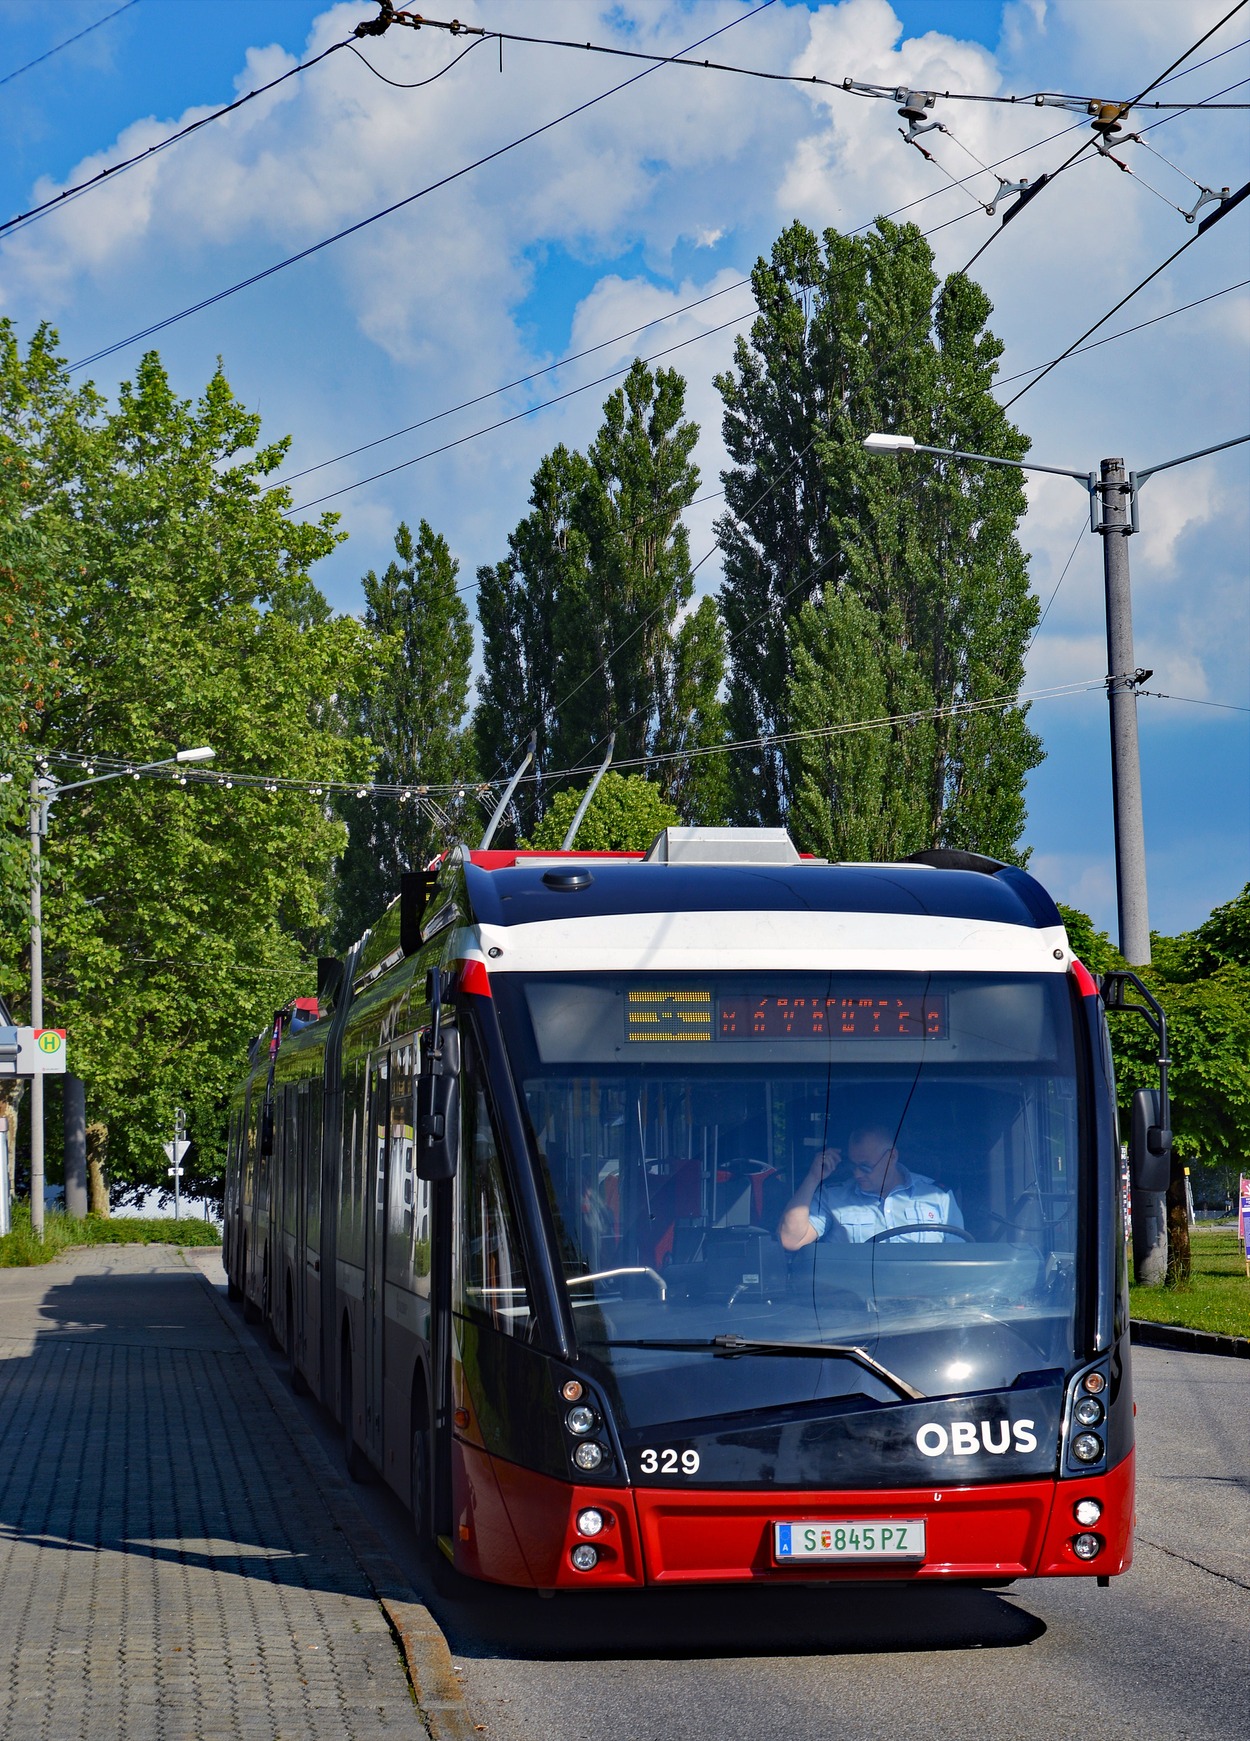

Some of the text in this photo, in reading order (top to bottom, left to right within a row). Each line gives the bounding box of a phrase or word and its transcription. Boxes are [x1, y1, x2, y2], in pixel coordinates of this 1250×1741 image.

[44, 1036, 55, 1050] H
[915, 1419, 1038, 1457] OBUS
[640, 1448, 701, 1475] 329
[782, 1543, 789, 1552] A
